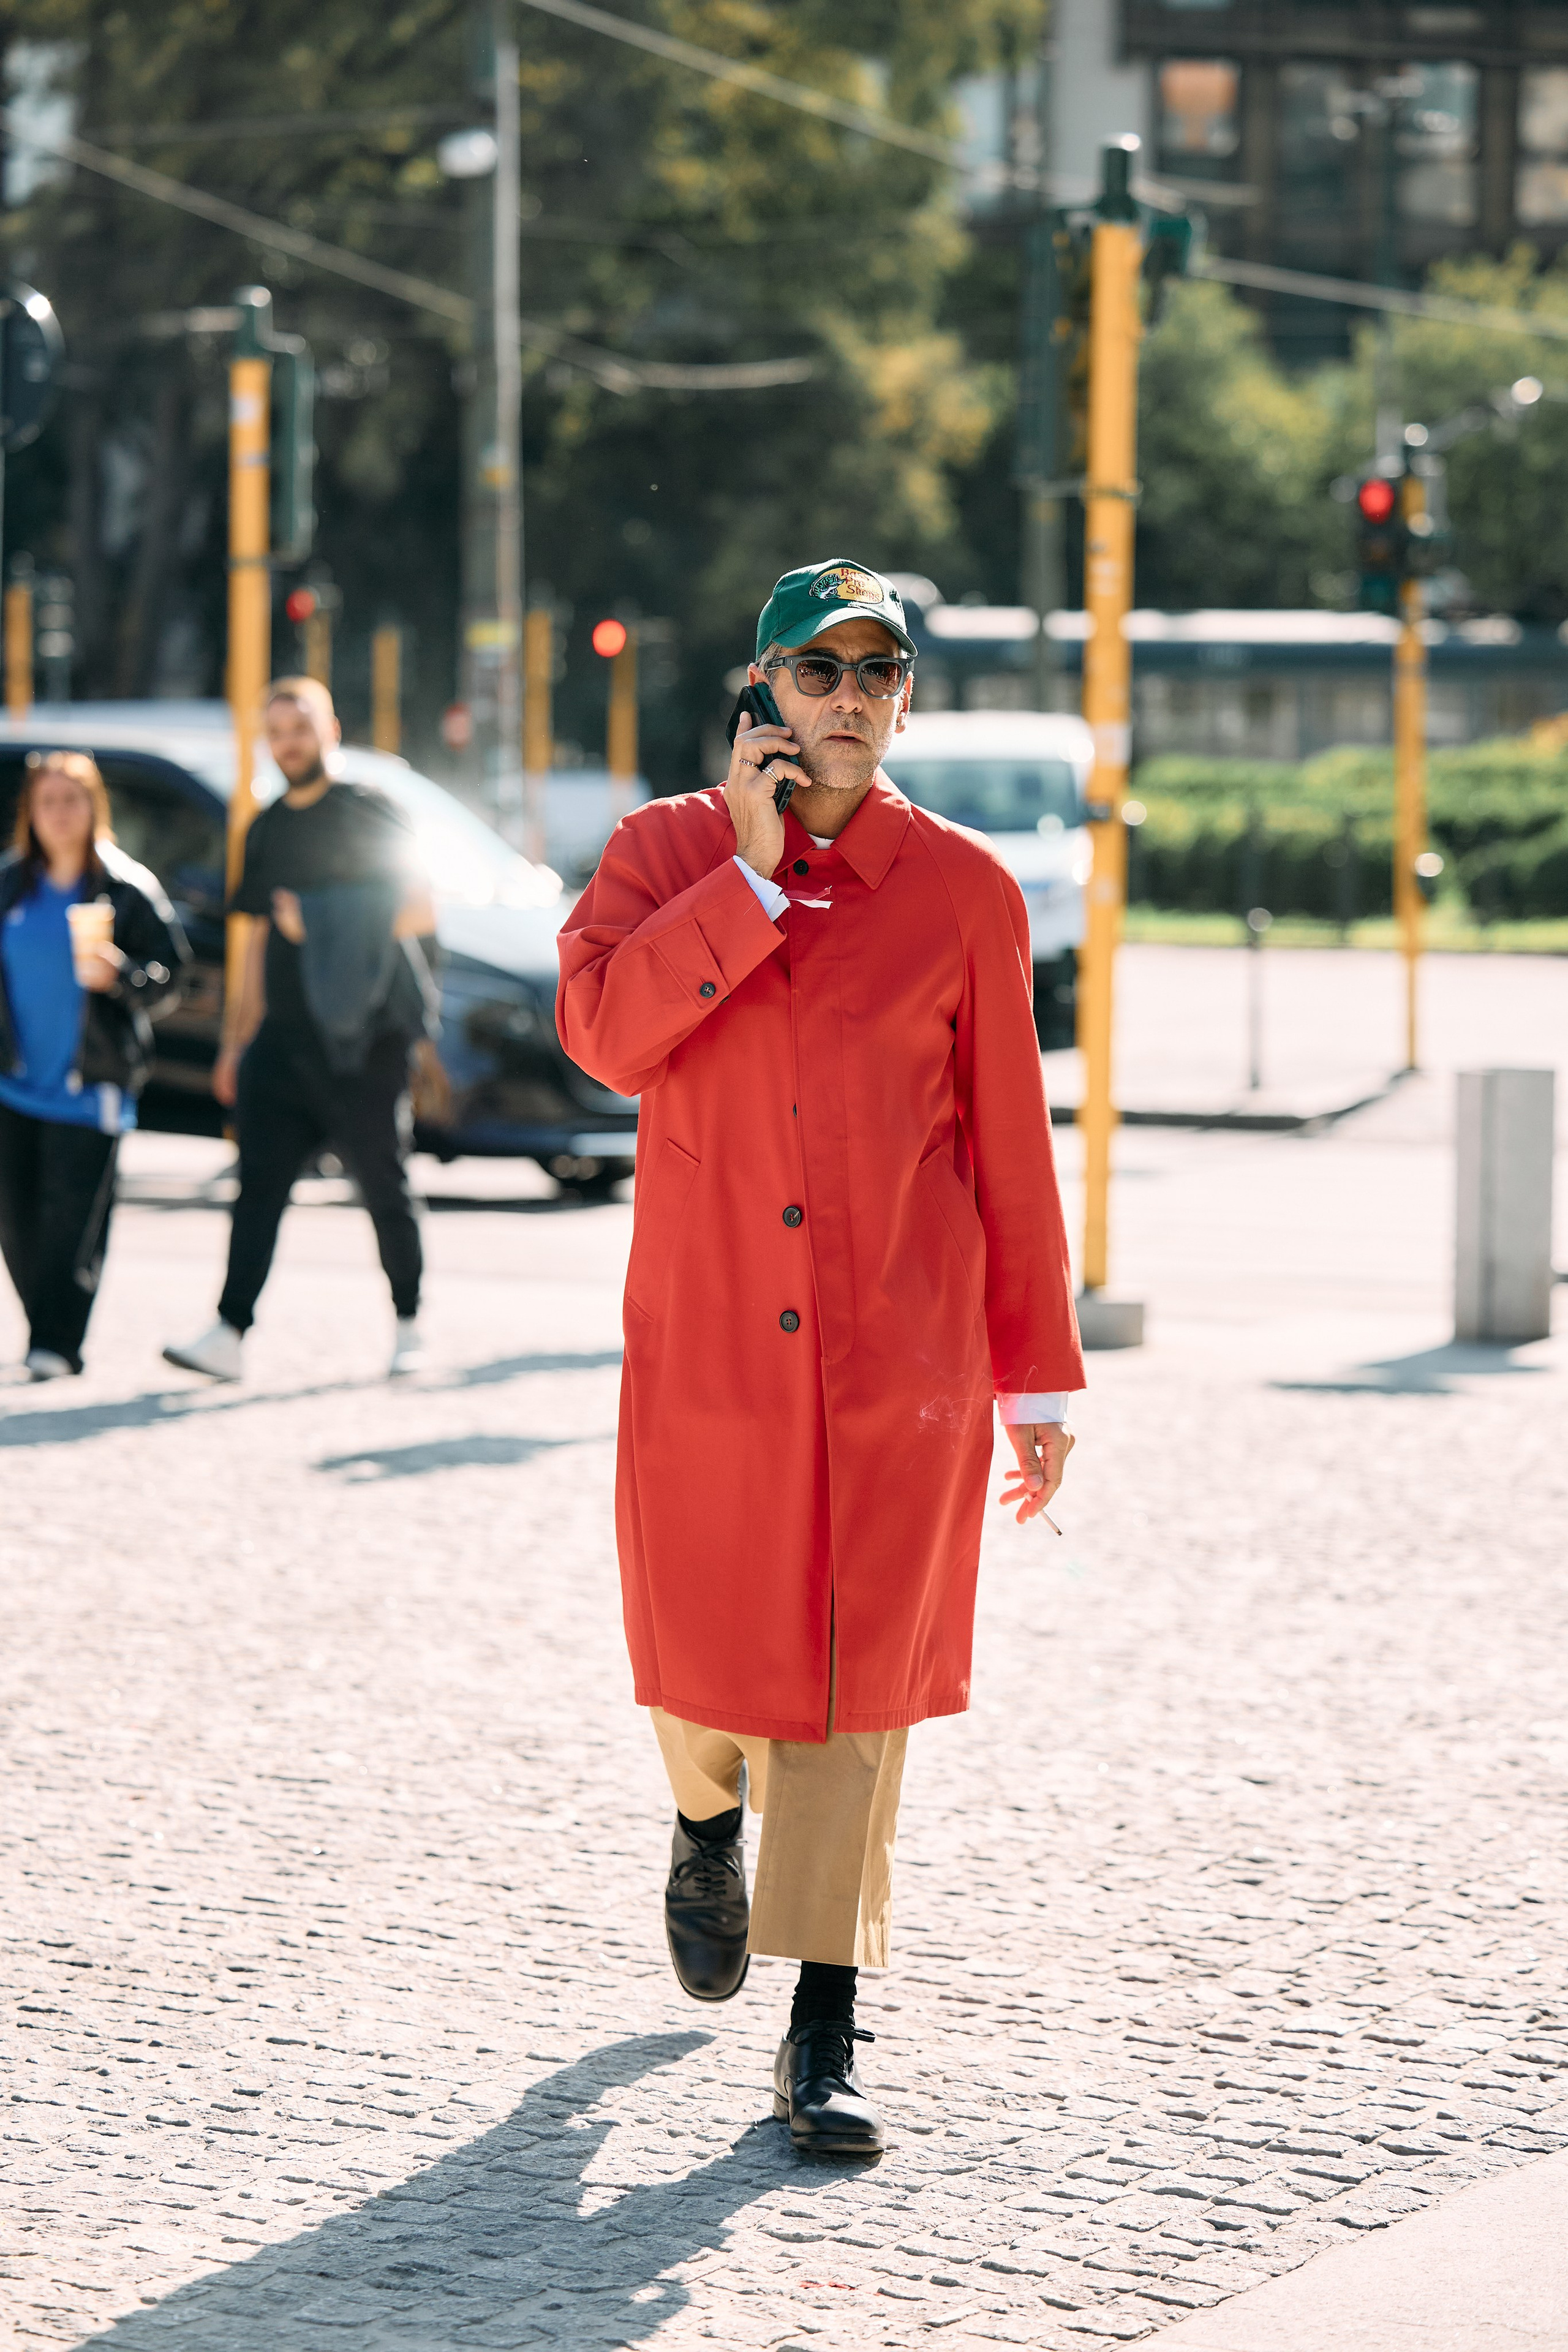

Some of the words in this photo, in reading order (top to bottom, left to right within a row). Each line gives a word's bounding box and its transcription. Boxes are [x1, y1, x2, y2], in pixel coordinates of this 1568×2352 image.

[841, 568, 869, 581] Bass
[845, 576, 865, 587] Pro
[846, 584, 880, 601] Shops
